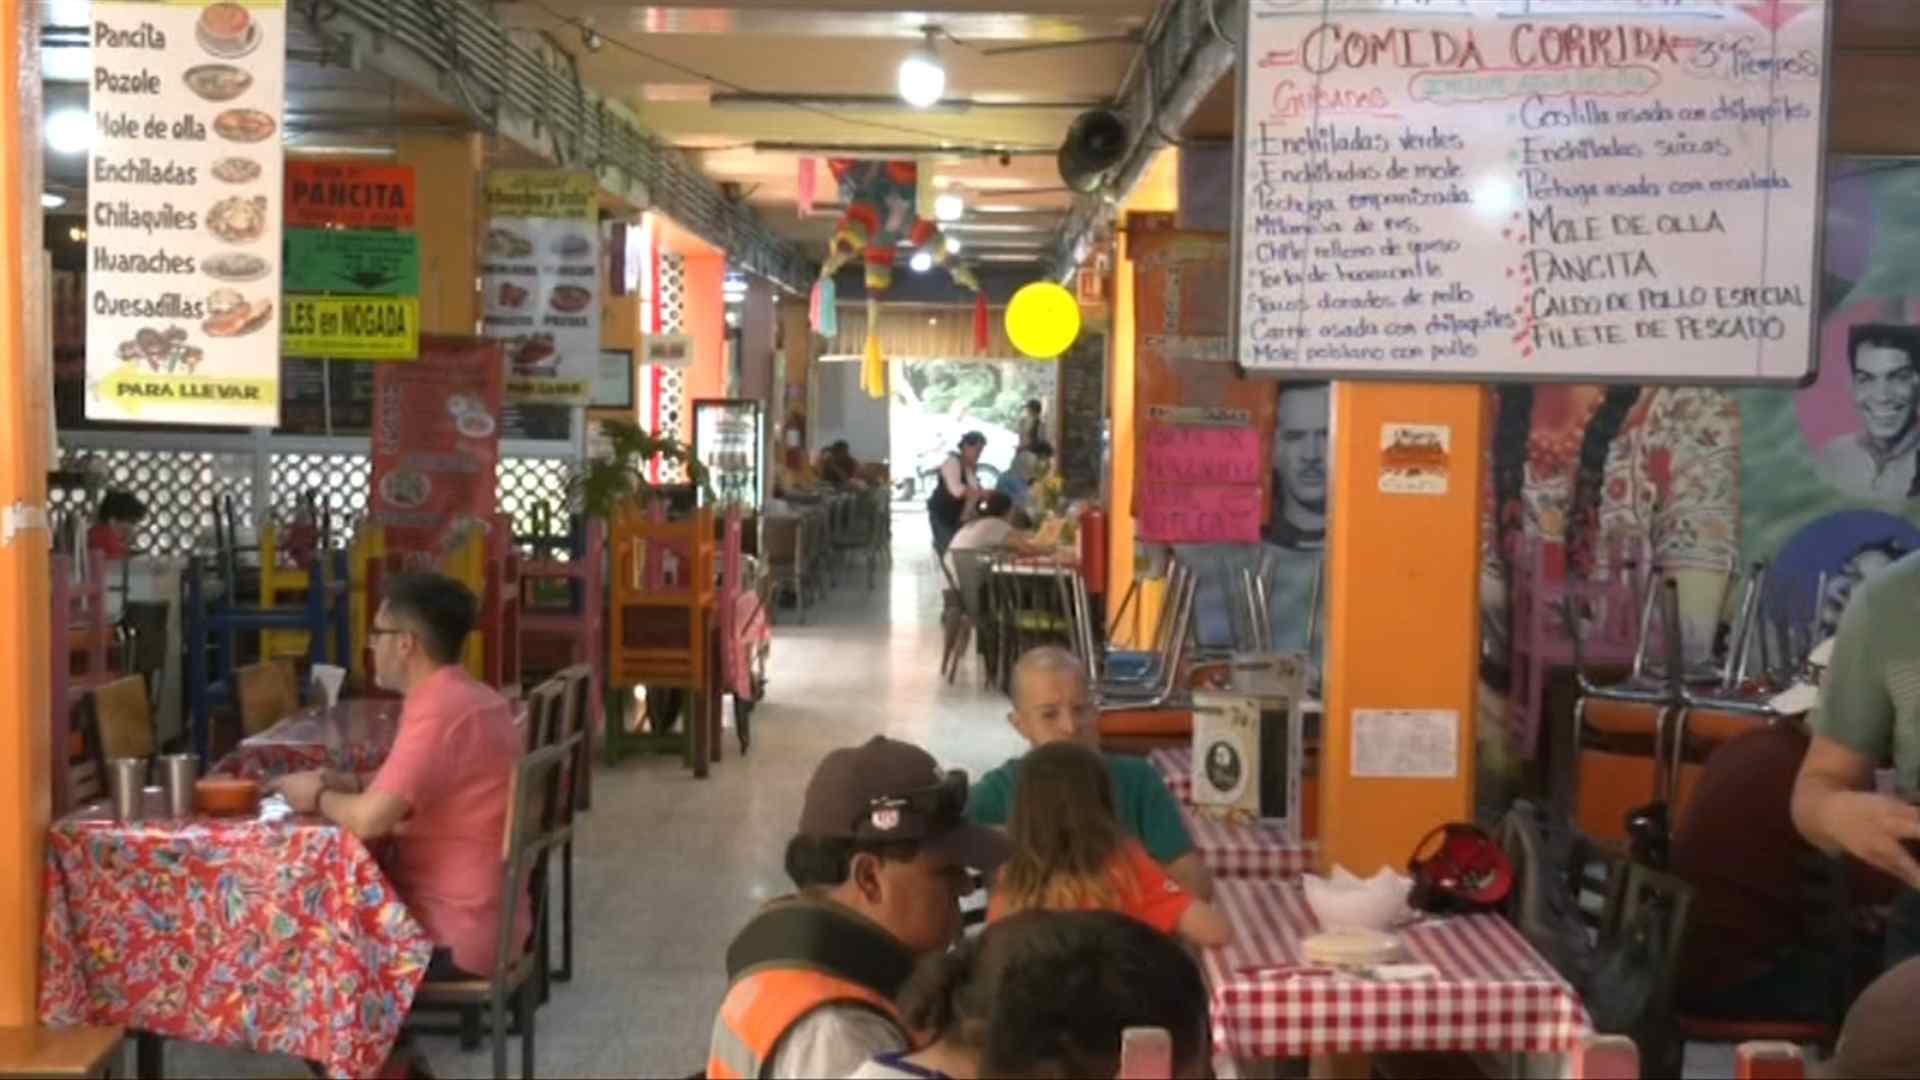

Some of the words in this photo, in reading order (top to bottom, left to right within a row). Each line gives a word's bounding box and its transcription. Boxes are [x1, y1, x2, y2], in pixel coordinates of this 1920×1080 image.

[94, 20, 166, 49] Pancita
[1302, 23, 1485, 75] COMIDA
[1510, 22, 1678, 66] CORRIDA
[94, 66, 161, 94] Pozole
[1519, 94, 1610, 129] Costilla
[1679, 107, 1705, 121] con
[144, 113, 168, 140] de
[172, 114, 206, 141] olla
[1255, 121, 1390, 155] Enchiladas
[1400, 126, 1465, 150] verdes
[1519, 135, 1643, 165] Enchiladas
[94, 157, 197, 185] Enchiladas
[1257, 160, 1382, 183] Enchiladas
[1387, 157, 1411, 179] de
[1414, 157, 1462, 179] mole
[292, 180, 406, 210] PANCITA
[1604, 173, 1662, 197] asada
[1667, 180, 1705, 195] con
[94, 201, 197, 234] Chilaquiles
[1354, 216, 1375, 234] de
[1528, 203, 1599, 246] MOLE
[1611, 213, 1651, 236] DE
[1656, 210, 1725, 236] OLLA
[93, 246, 196, 274] Huaraches
[1308, 264, 1329, 282] de
[1523, 249, 1658, 283] PANCITA
[94, 290, 204, 319] Quesadillas
[1317, 290, 1396, 310] dorados
[1401, 287, 1422, 306] de
[1431, 281, 1475, 307] pollo
[1530, 287, 1600, 321] CALDO
[1606, 292, 1634, 312] DE
[1637, 286, 1707, 311] POLLO
[1715, 285, 1808, 309] ESPECIAL
[319, 309, 338, 336] en
[341, 303, 407, 337] NOGADA
[1319, 316, 1377, 338] asada
[1384, 321, 1417, 337] con
[1531, 323, 1625, 349] FILETE
[1636, 319, 1669, 339] DE
[1675, 317, 1785, 341] PESCADO
[1252, 342, 1297, 363] Mole
[1305, 343, 1384, 362] poblano
[1390, 345, 1423, 360] con
[1430, 337, 1479, 361] pollo
[116, 381, 175, 398] PARA
[180, 382, 260, 400] LLEVAR
